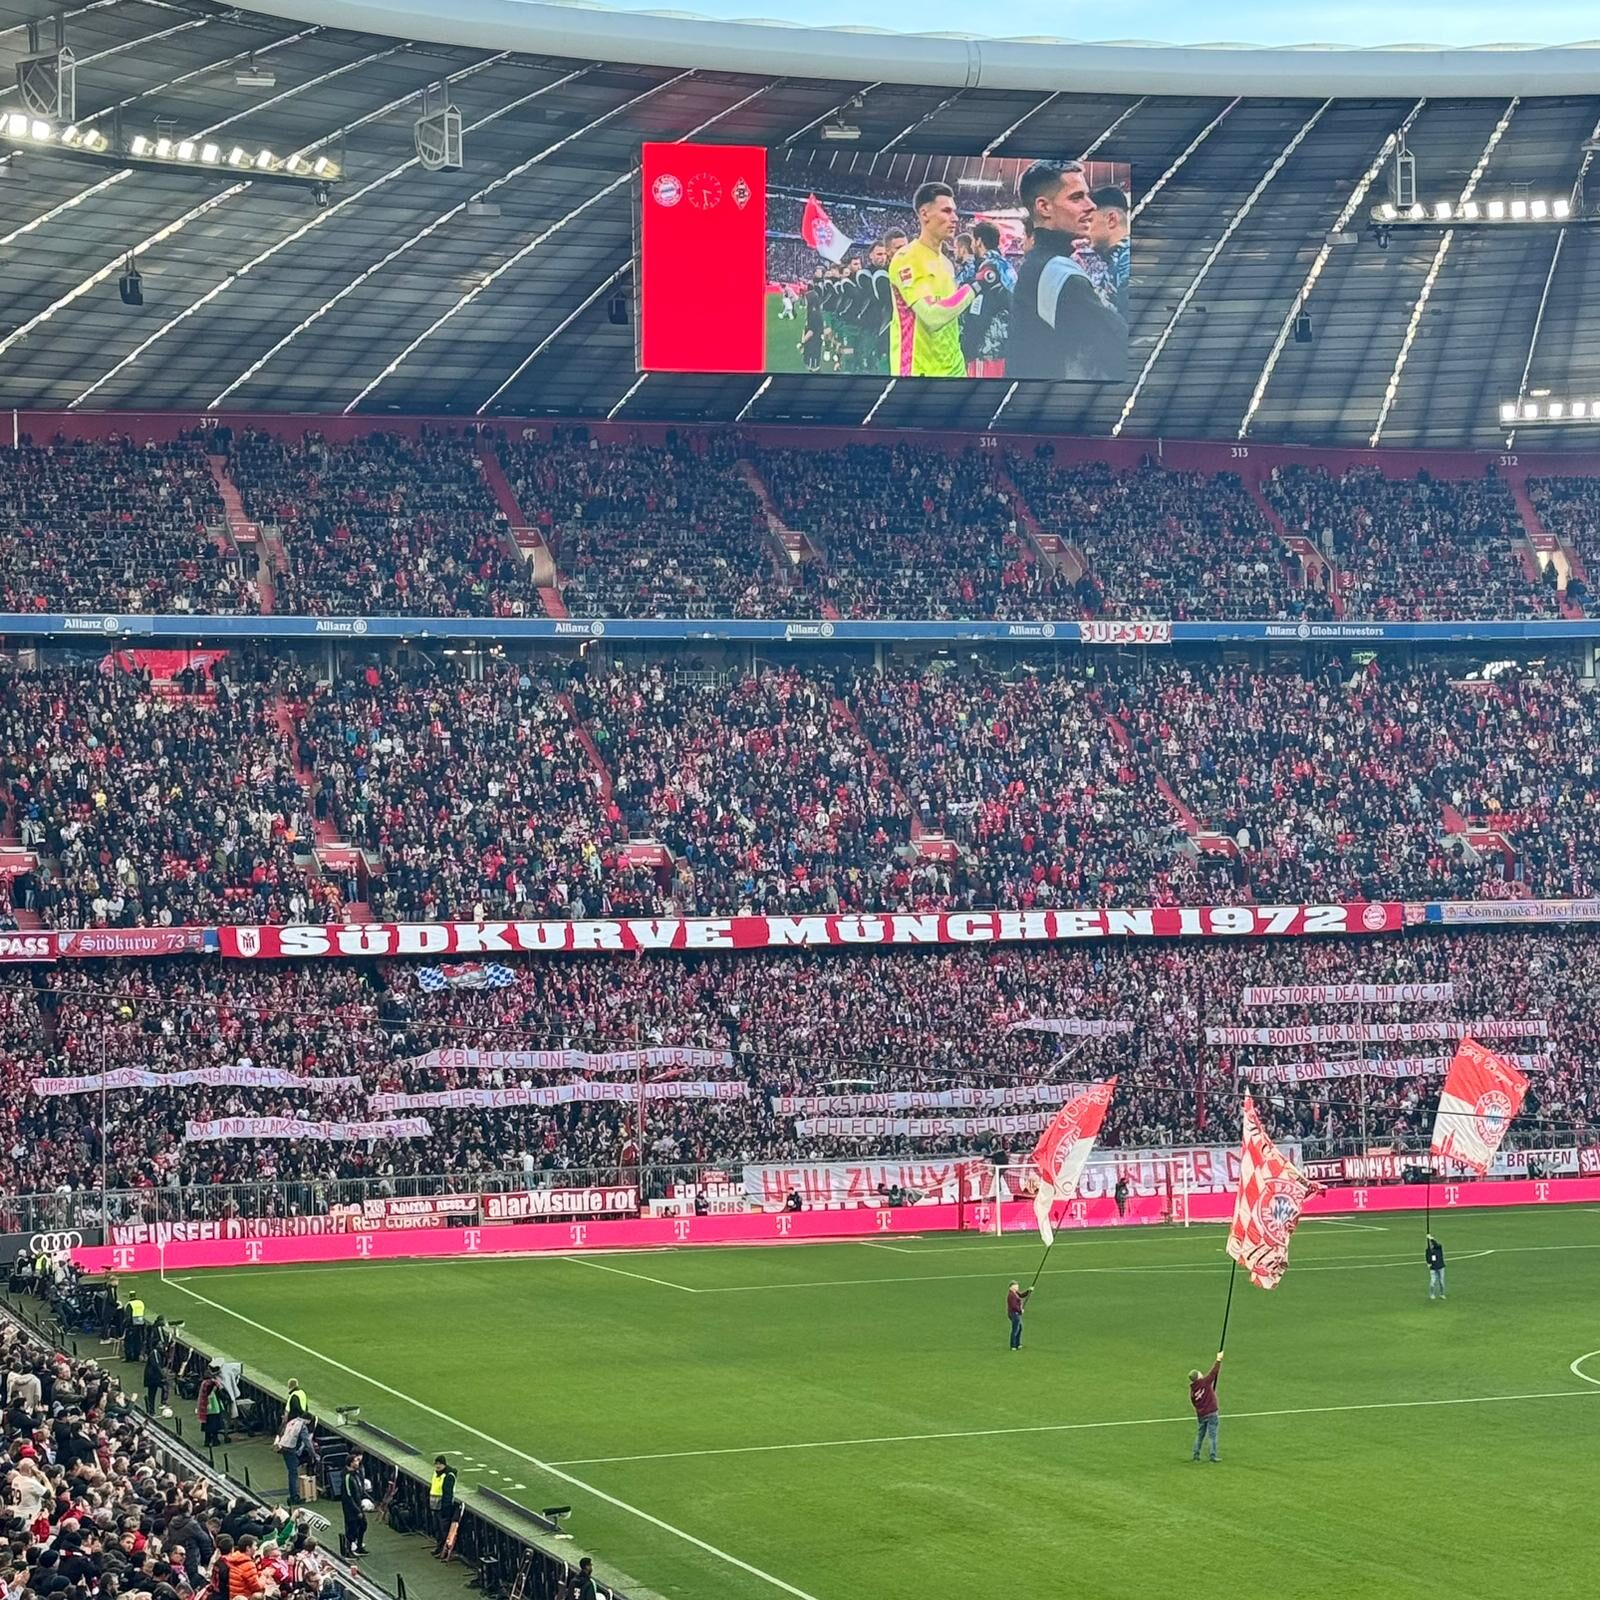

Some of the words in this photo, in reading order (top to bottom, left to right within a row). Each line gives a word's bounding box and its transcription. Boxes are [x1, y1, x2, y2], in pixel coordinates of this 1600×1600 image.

[979, 437, 998, 448] 314
[1231, 447, 1249, 458] 313
[1500, 456, 1519, 466] 312
[63, 618, 101, 630] Allianz
[315, 620, 352, 632] Allianz
[554, 623, 590, 633] Allianz
[786, 624, 819, 634] Allianz
[1008, 625, 1041, 636] Allianz
[1265, 625, 1297, 637] Allianz
[1311, 625, 1340, 636] Global
[1341, 626, 1385, 636] Investors
[1079, 622, 1136, 643] SUPS
[1140, 622, 1170, 641] 94
[279, 920, 735, 956] SÜDKURVE
[767, 908, 1154, 944] MÜNCHEN
[1179, 905, 1348, 935] 1972
[79, 934, 158, 951] Südkurve
[1250, 985, 1369, 1002] INVESTOREN-DEAL
[1375, 986, 1397, 1001] MIT
[1401, 985, 1430, 1000] CVC
[1211, 1029, 1222, 1044] 3
[1225, 1028, 1249, 1044] MIO
[1268, 1026, 1313, 1044] BONUS
[1346, 1024, 1371, 1040] DEN
[1376, 1023, 1441, 1040] LIGA-BOSS
[1445, 1023, 1458, 1038] IN
[1463, 1021, 1541, 1039] FRANKREICH
[454, 1050, 572, 1068] BLACKSTONE
[1294, 1064, 1327, 1080] BONI
[572, 1085, 586, 1100] IN
[591, 1084, 624, 1099] DER
[780, 1093, 897, 1114] BLACKSTONE
[910, 1093, 942, 1107] GUT
[803, 1118, 898, 1136] SCHLECHT
[488, 1190, 603, 1217] alarMstufe
[606, 1189, 637, 1210] rot
